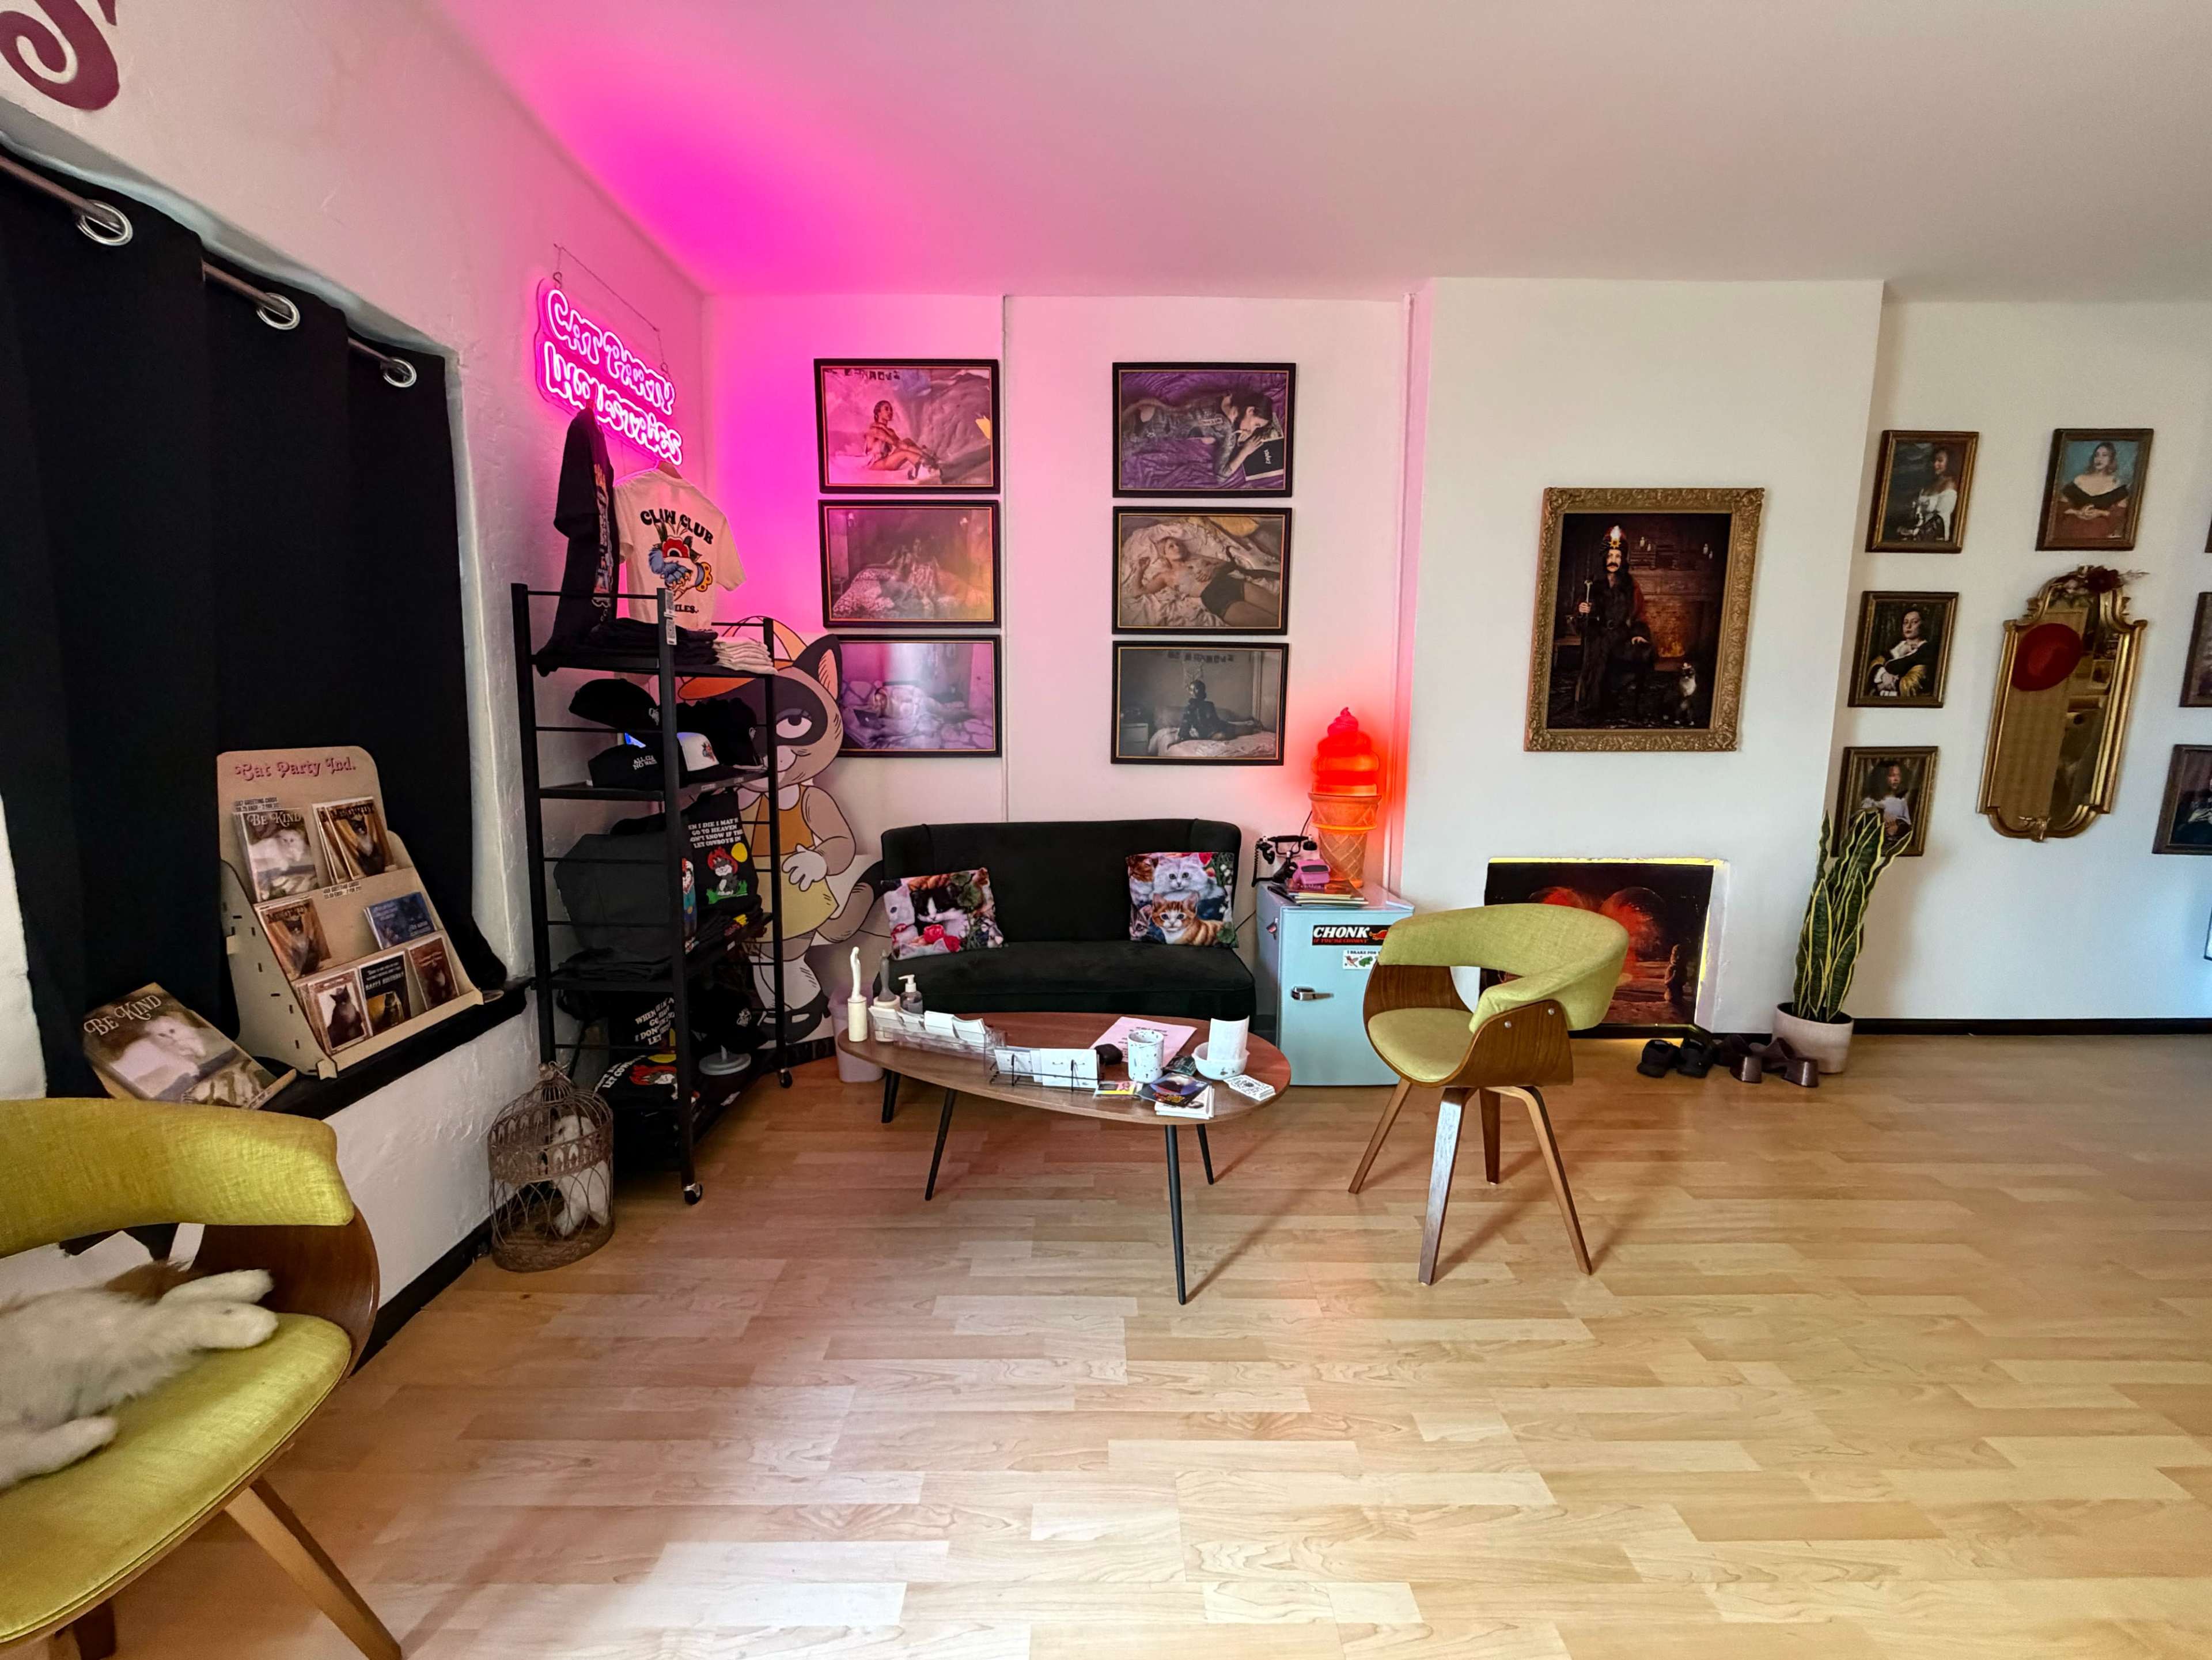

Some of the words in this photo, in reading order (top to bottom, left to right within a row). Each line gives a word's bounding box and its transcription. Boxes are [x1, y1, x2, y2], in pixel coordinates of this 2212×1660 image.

[235, 763, 271, 781] Cat
[276, 761, 320, 778] Party
[247, 814, 268, 826] BE
[270, 811, 301, 827] KIND
[1313, 927, 1370, 938] CHONK
[84, 1016, 119, 1036] BE
[115, 995, 162, 1020] KIND
[635, 1009, 656, 1024] WHEN
[647, 1034, 661, 1045] LET
